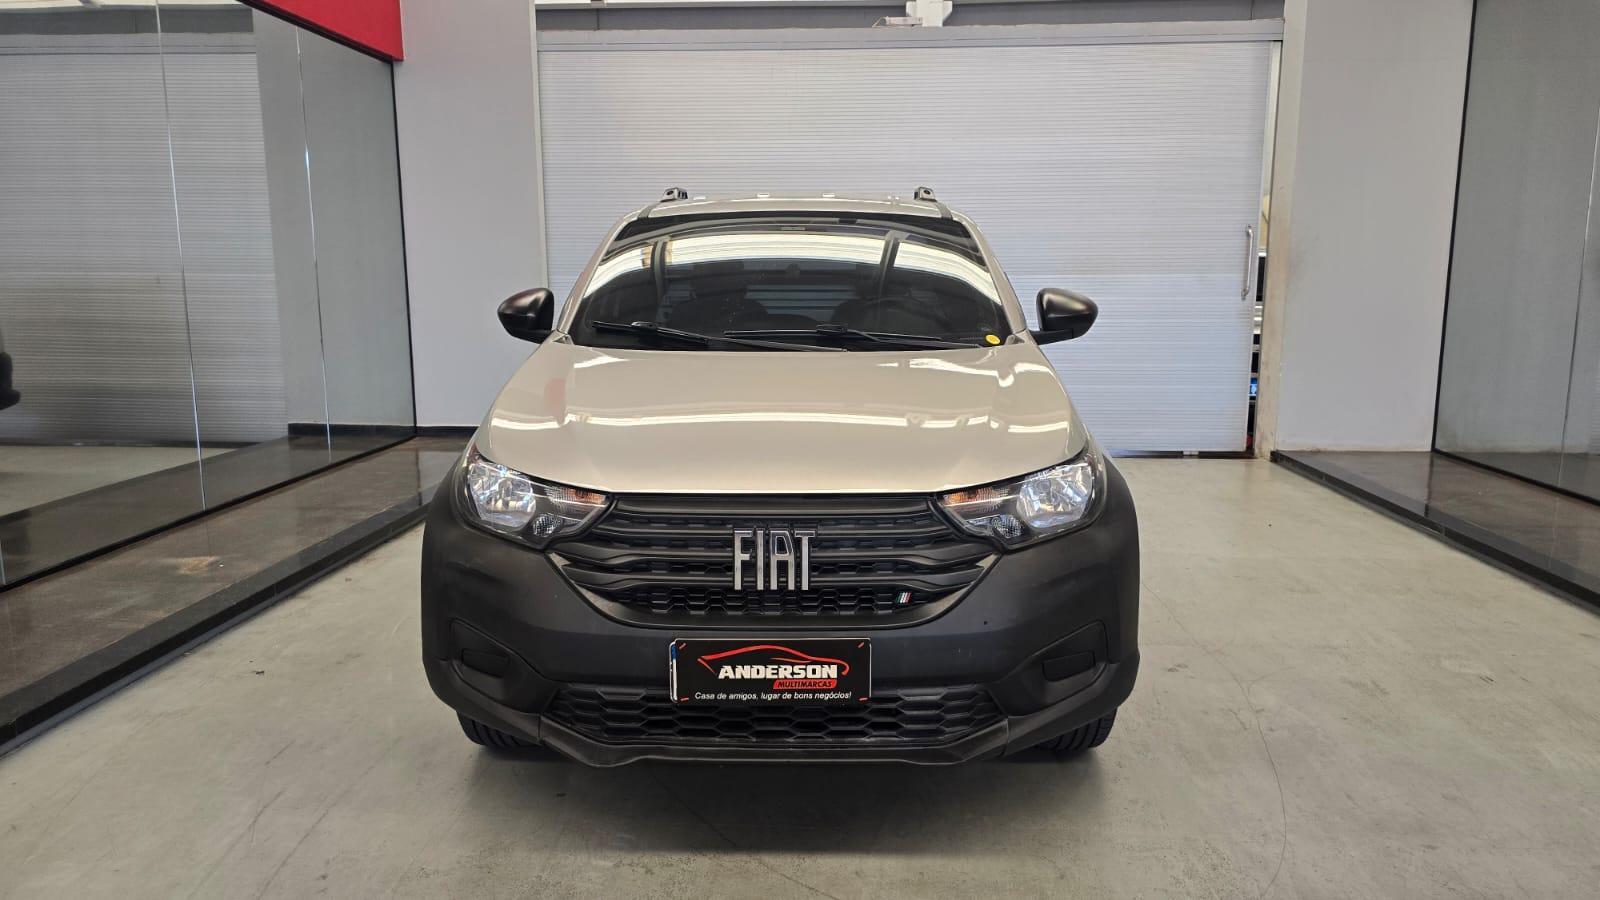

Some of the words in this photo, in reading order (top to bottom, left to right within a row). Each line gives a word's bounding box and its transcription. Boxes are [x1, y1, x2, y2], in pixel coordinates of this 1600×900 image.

[733, 529, 816, 591] FIAT
[718, 664, 838, 679] ANDERSON
[777, 680, 832, 688] MULTIMARCAS
[694, 691, 716, 700] Casa
[716, 691, 728, 700] de
[728, 692, 759, 701] amigos,
[760, 691, 781, 701] lugar
[781, 691, 793, 700] de
[793, 691, 813, 700] bons
[814, 691, 852, 701] negócios!
